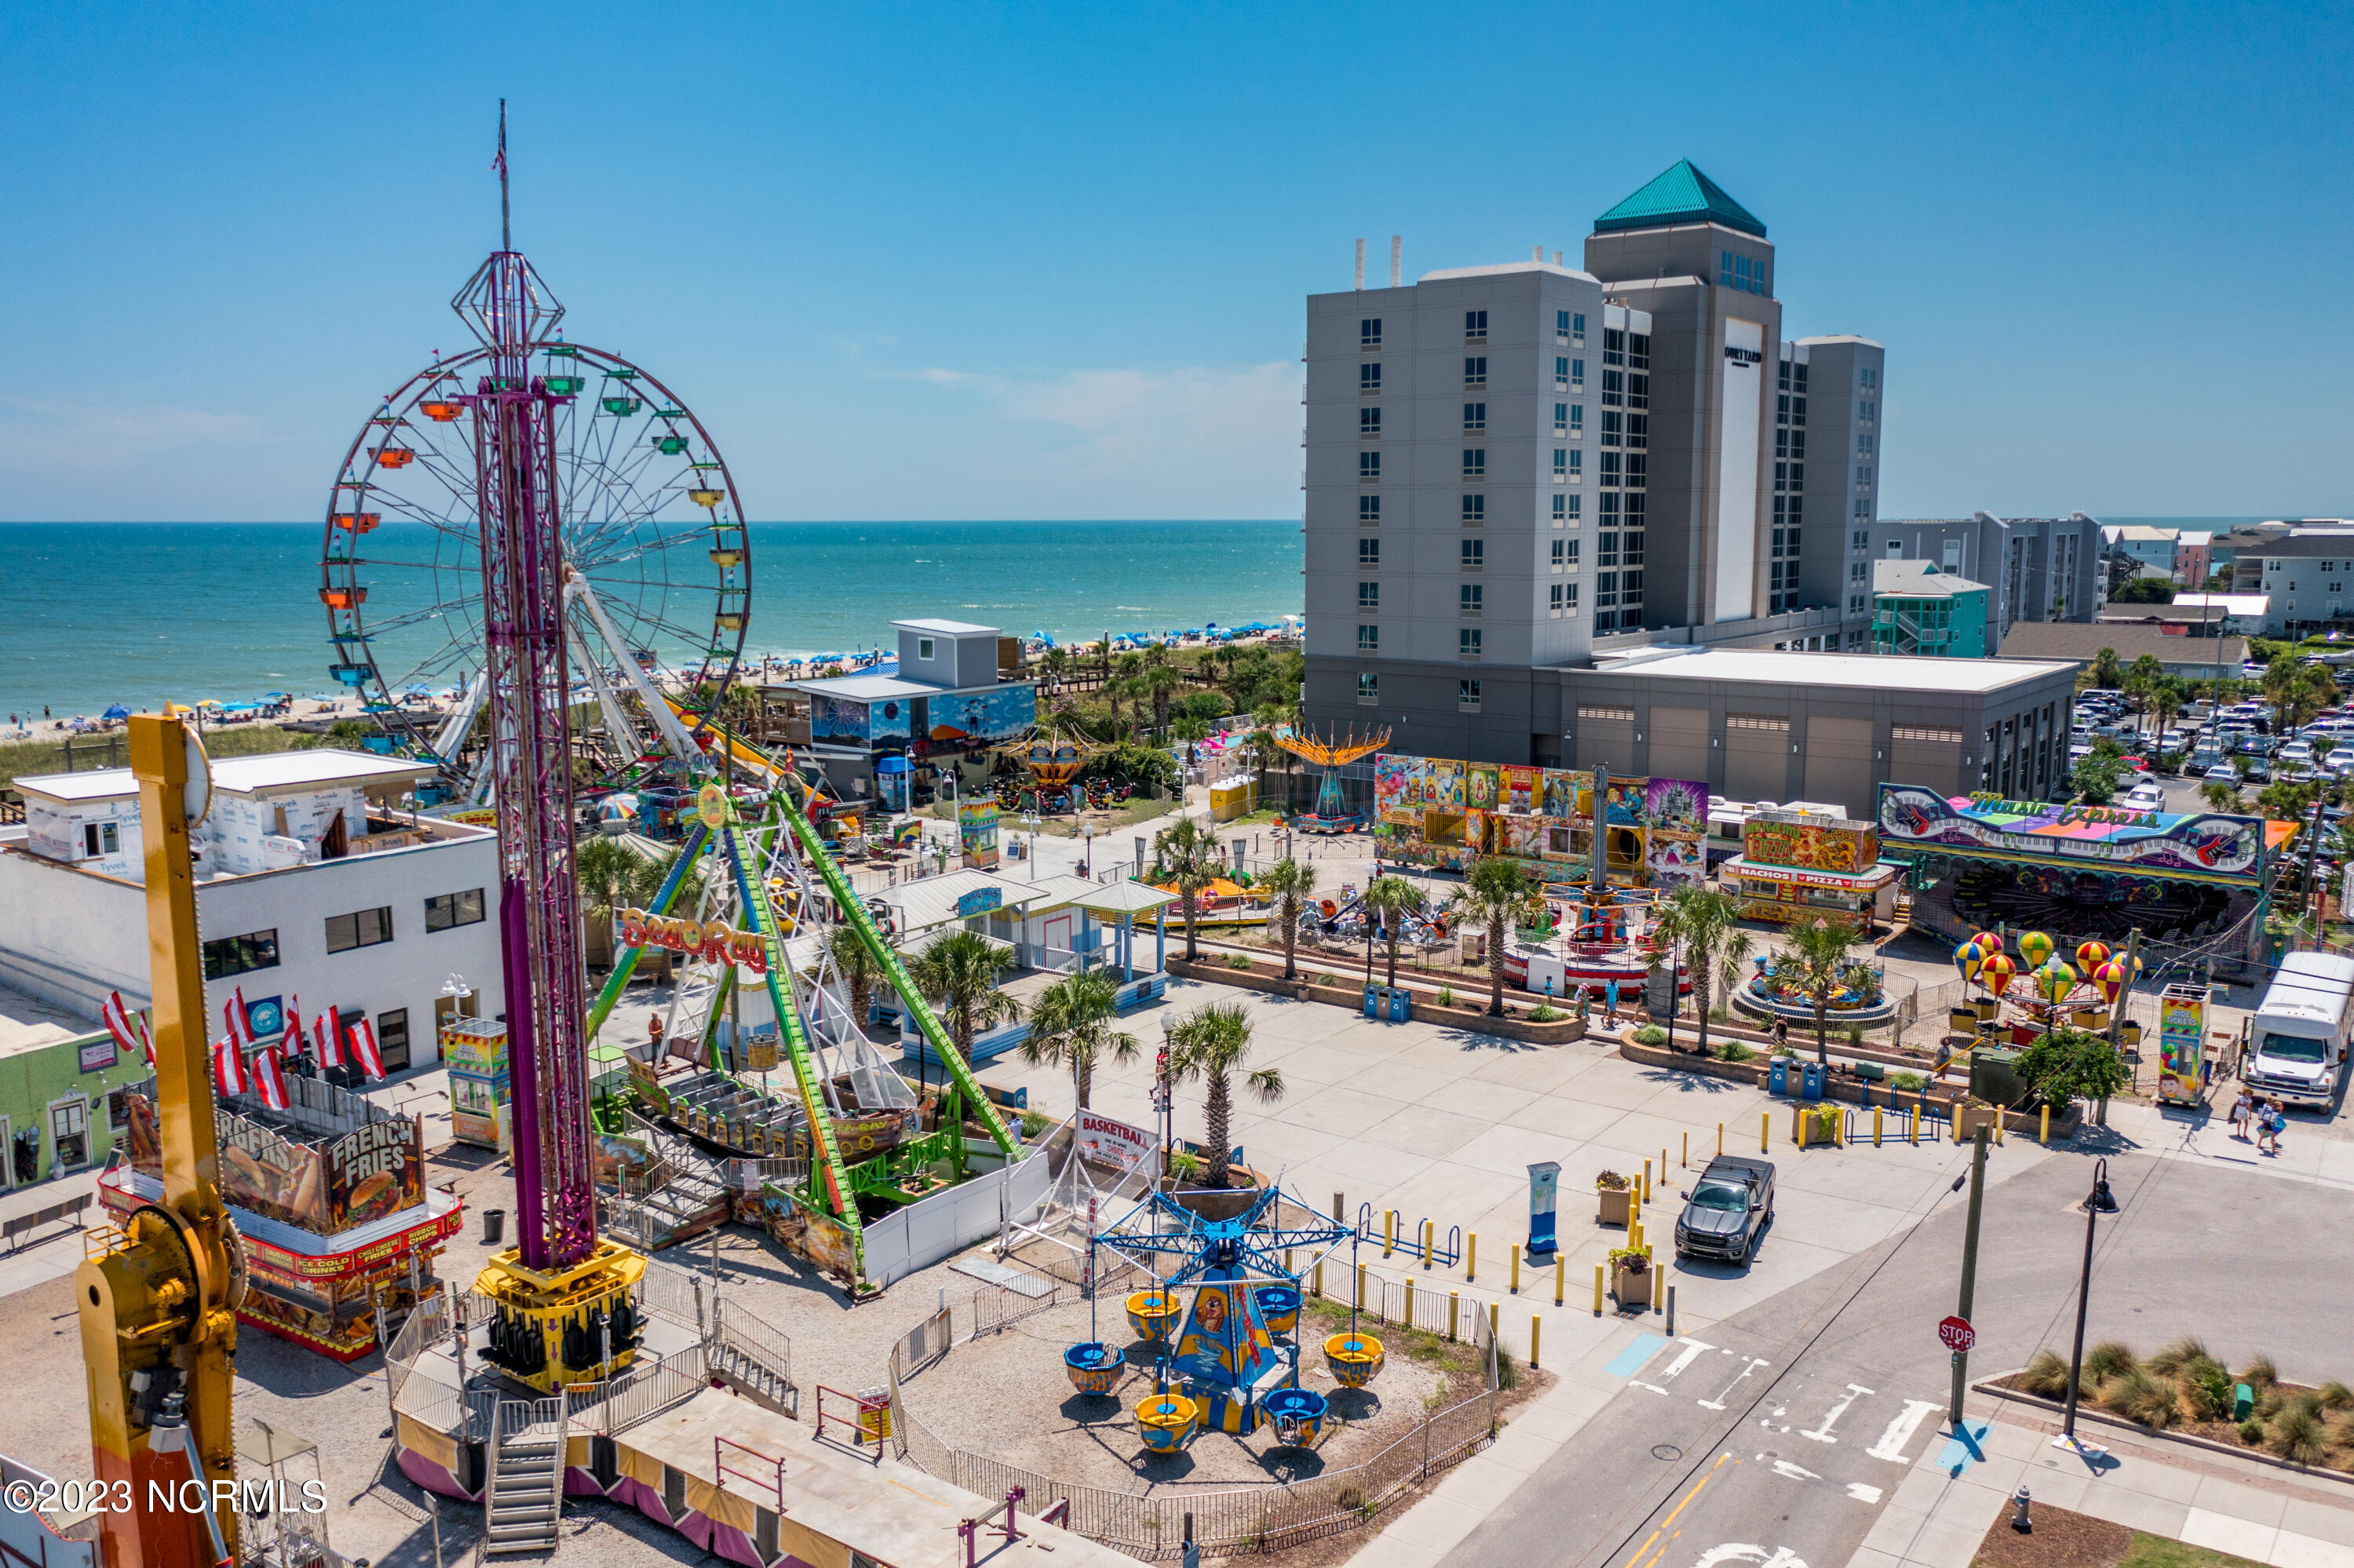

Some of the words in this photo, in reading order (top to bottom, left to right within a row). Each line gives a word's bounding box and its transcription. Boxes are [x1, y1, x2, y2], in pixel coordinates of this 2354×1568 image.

[1724, 346, 1761, 363] OURTYARD
[1969, 791, 2050, 818] Music
[2058, 800, 2160, 829] Express
[1746, 822, 1761, 835] NEW
[1761, 822, 1780, 833] YORK
[1782, 824, 1801, 841] STYLE
[1819, 830, 1856, 844] NACHOS
[1751, 837, 1791, 861] PIZZA
[1740, 867, 1790, 880] NACHOS
[1806, 875, 1842, 886] PIZZA
[2166, 1016, 2196, 1026] TICKETS
[452, 1050, 483, 1063] TICKETS
[458, 1044, 476, 1054] RIDE
[832, 1123, 854, 1132] EA
[859, 1121, 888, 1132] RAY
[220, 1113, 290, 1171] RGERS
[333, 1120, 414, 1172] FRENCH
[1108, 1144, 1124, 1154] CHOICE
[345, 1145, 405, 1187] FRIES
[408, 1223, 437, 1239] RIBBON
[408, 1229, 438, 1245] CHIPS
[358, 1248, 374, 1259] CHILI
[375, 1238, 399, 1253] CHEESE
[364, 1247, 392, 1263] FRIES
[302, 1264, 345, 1274] DRINKS
[317, 1257, 349, 1267] COLD
[1940, 1324, 1973, 1343] STOP
